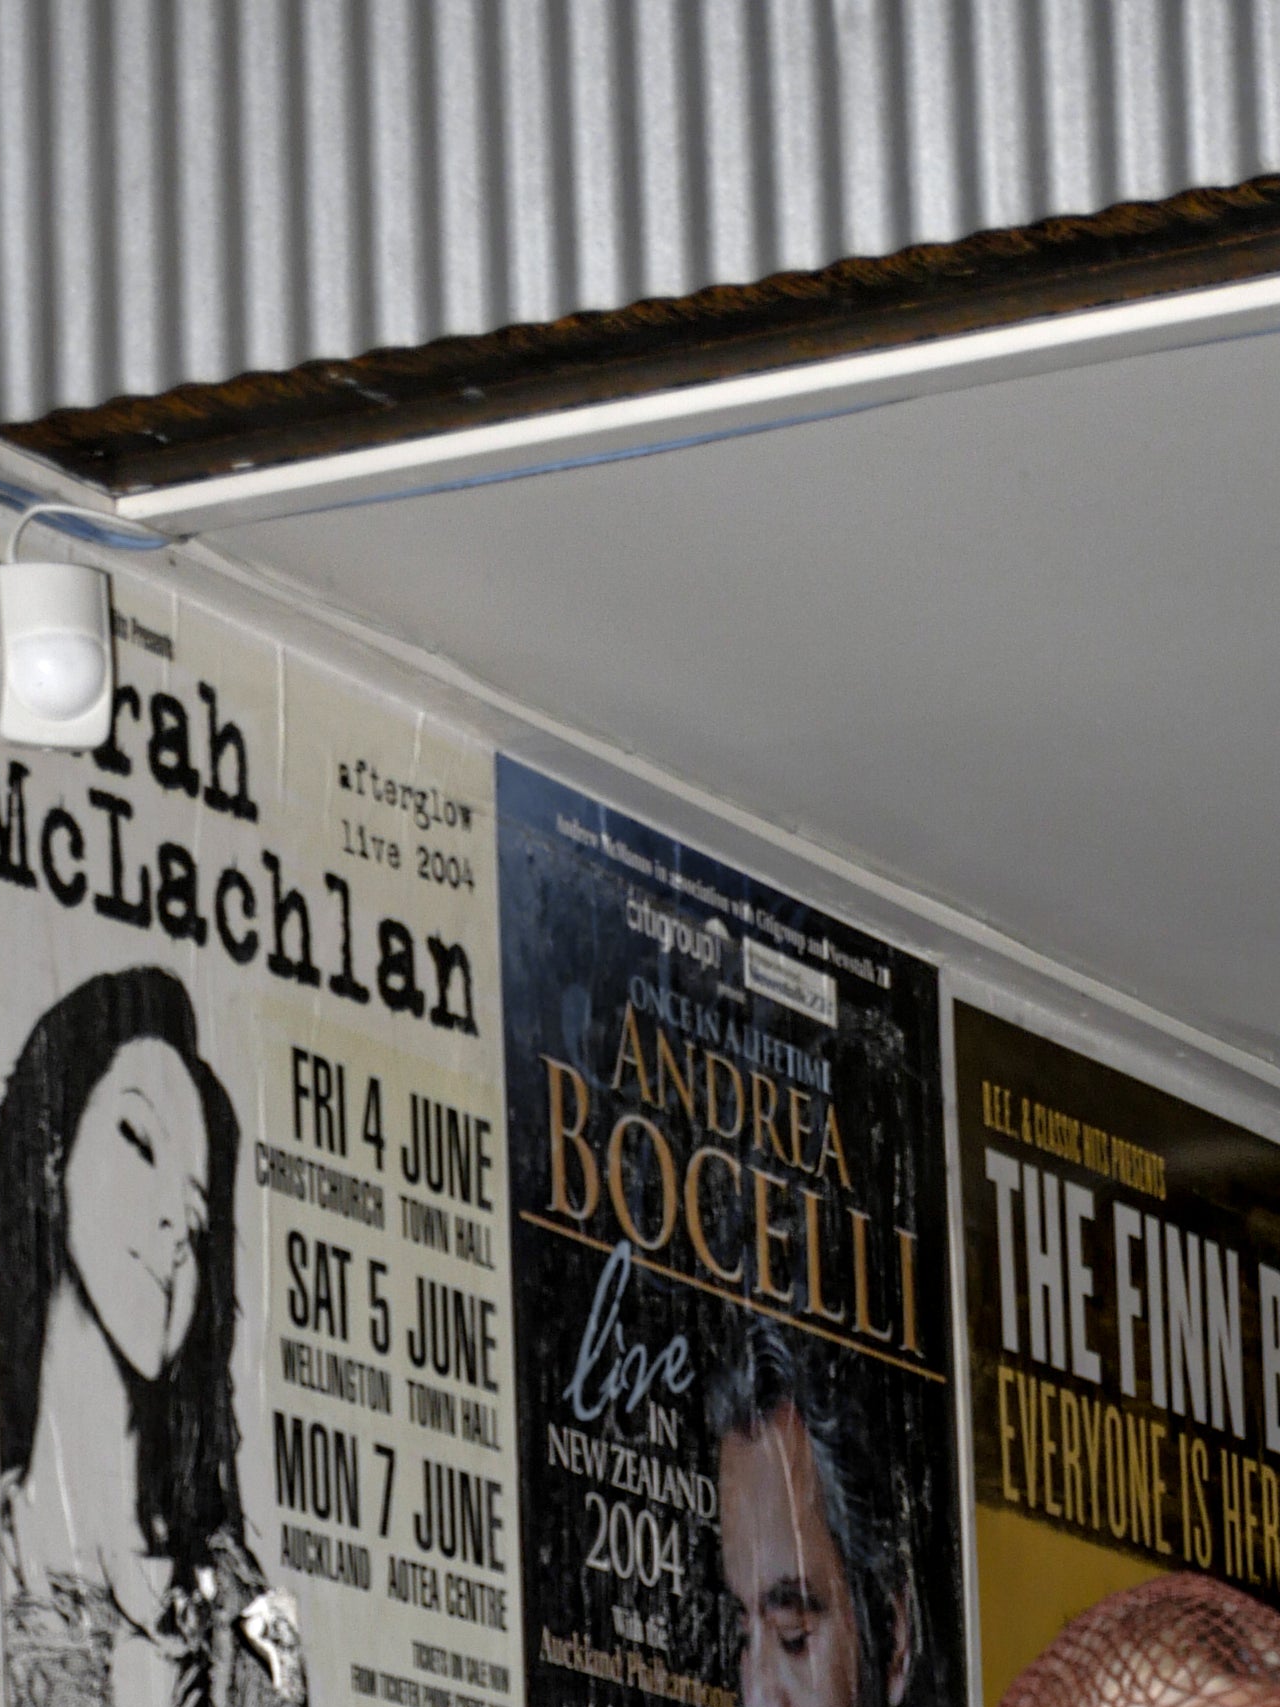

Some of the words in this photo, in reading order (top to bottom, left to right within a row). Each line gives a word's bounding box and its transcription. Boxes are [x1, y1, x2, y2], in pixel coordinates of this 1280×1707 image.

[338, 759, 473, 831] afterglow
[342, 820, 401, 870] live
[419, 851, 475, 893] 2004
[612, 999, 855, 1193] ANDREA
[726, 1019, 742, 1055] A
[291, 1046, 348, 1159] FRI
[363, 1077, 385, 1172] 4
[402, 1093, 494, 1213] JUNE
[255, 1141, 386, 1231] CHRISTCHURCH
[400, 1195, 450, 1255] TOWN
[454, 1215, 497, 1271] HALL
[540, 1054, 925, 1360] BOCELLI
[287, 1230, 351, 1342] SAT
[368, 1258, 390, 1355] 5
[407, 1276, 499, 1394] JUNE
[563, 1240, 696, 1421] live
[985, 1147, 1102, 1385] THE
[1113, 1200, 1246, 1441] FINN
[280, 1337, 393, 1417] WELLINGTON
[406, 1379, 457, 1438] TOWN
[461, 1397, 502, 1451] HALL
[648, 1401, 680, 1451] IN
[274, 1410, 360, 1529] MON
[374, 1443, 396, 1539] 7
[414, 1458, 505, 1574] JUNE
[547, 1421, 609, 1482] NEW
[609, 1444, 717, 1519] ZEALAND
[998, 1365, 1173, 1556] EVERYONE
[1178, 1431, 1214, 1570] IS
[281, 1523, 371, 1592] AUCKLAND
[387, 1554, 442, 1613] AOTEA
[445, 1571, 509, 1633] CENTRE
[585, 1490, 686, 1597] 2004
